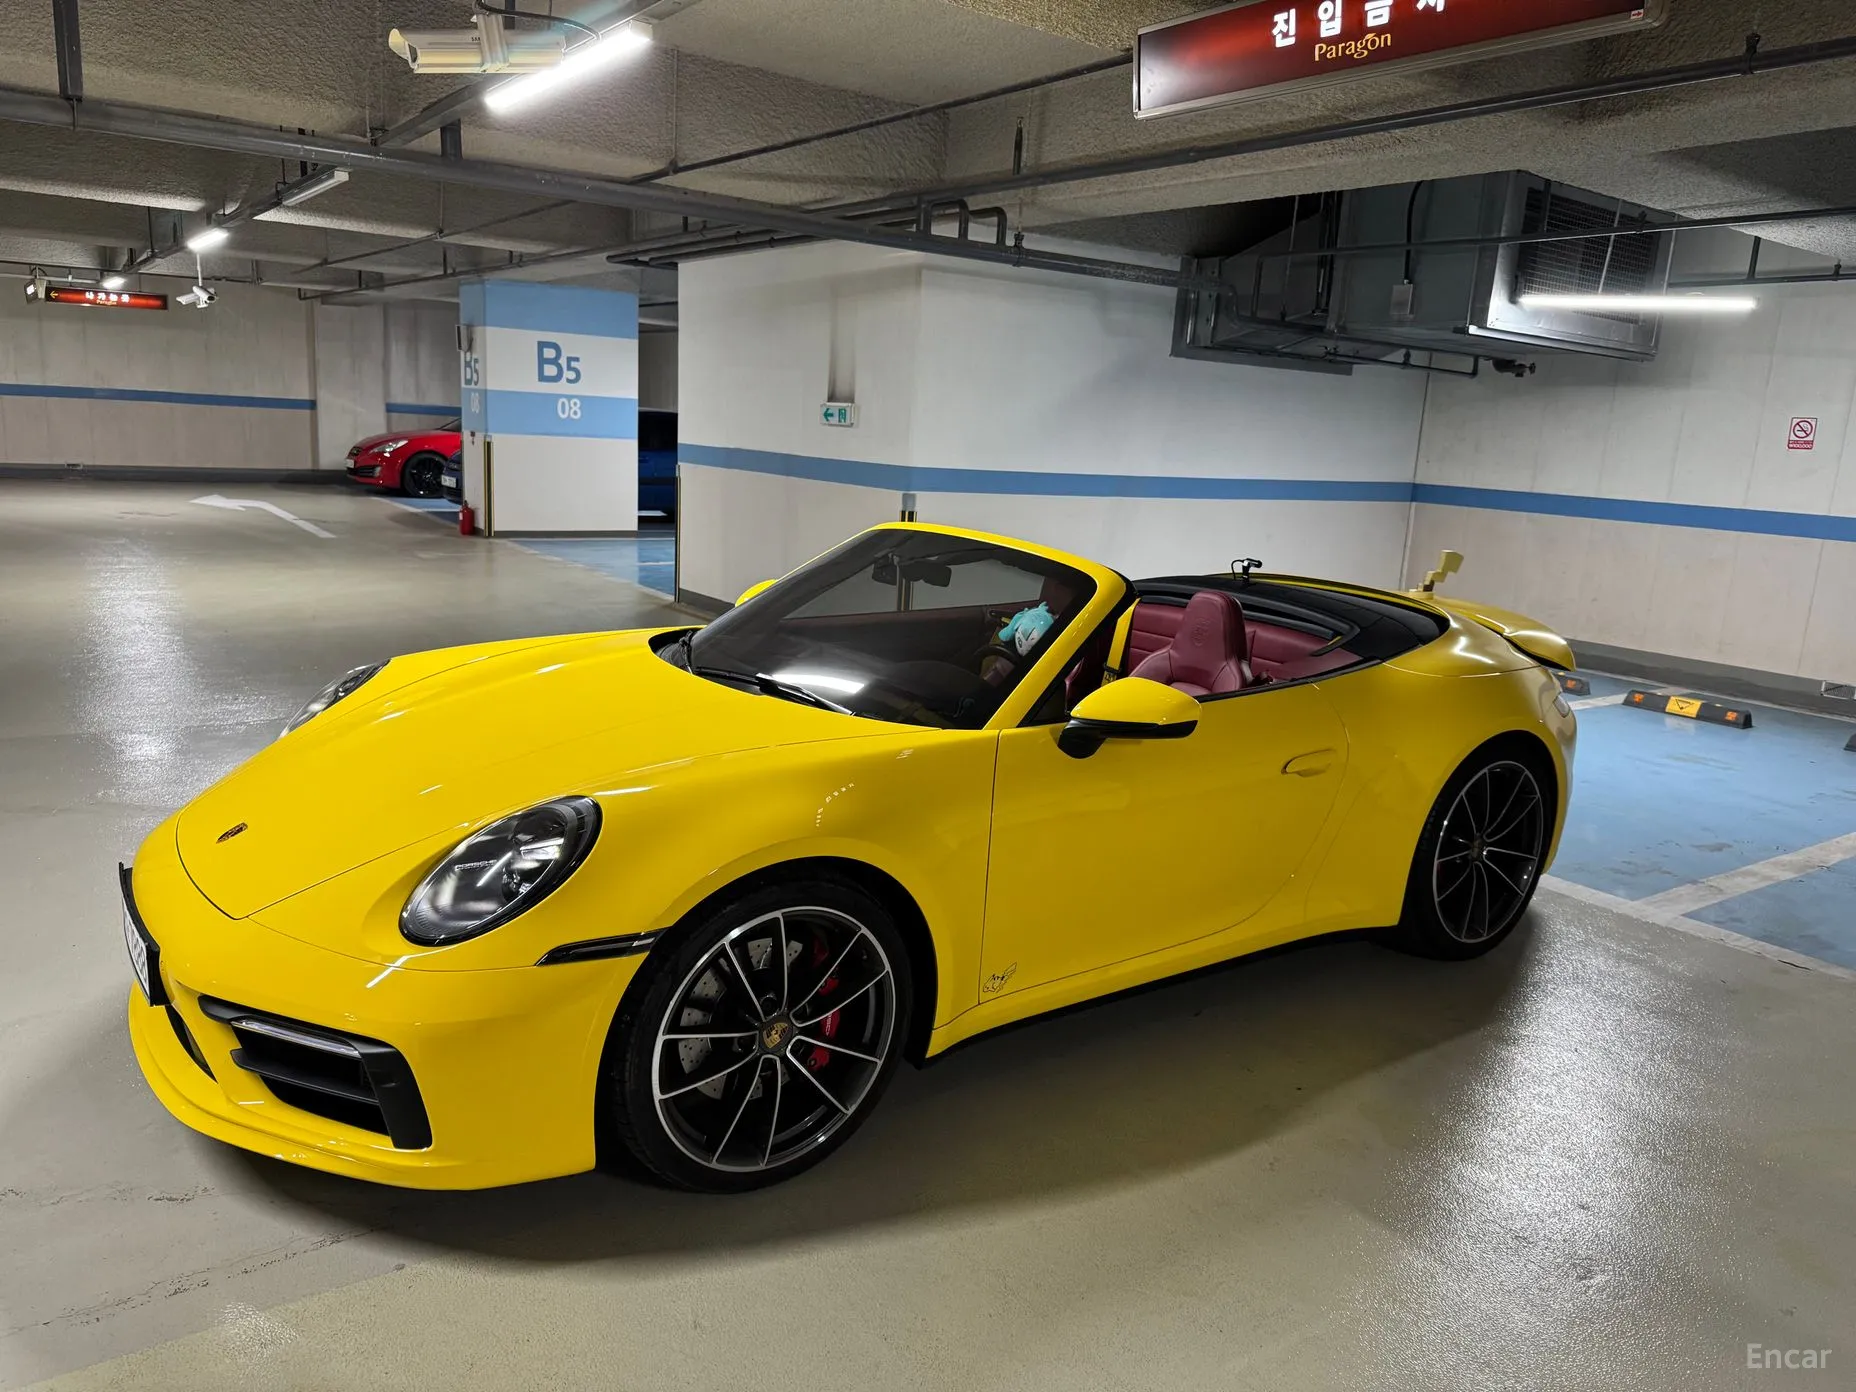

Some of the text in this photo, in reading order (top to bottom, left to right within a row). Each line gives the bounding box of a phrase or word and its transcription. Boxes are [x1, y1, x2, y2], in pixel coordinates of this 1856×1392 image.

[1314, 33, 1391, 62] Paragon
[464, 349, 480, 387] B5
[537, 340, 582, 385] B5
[557, 397, 582, 419] 08
